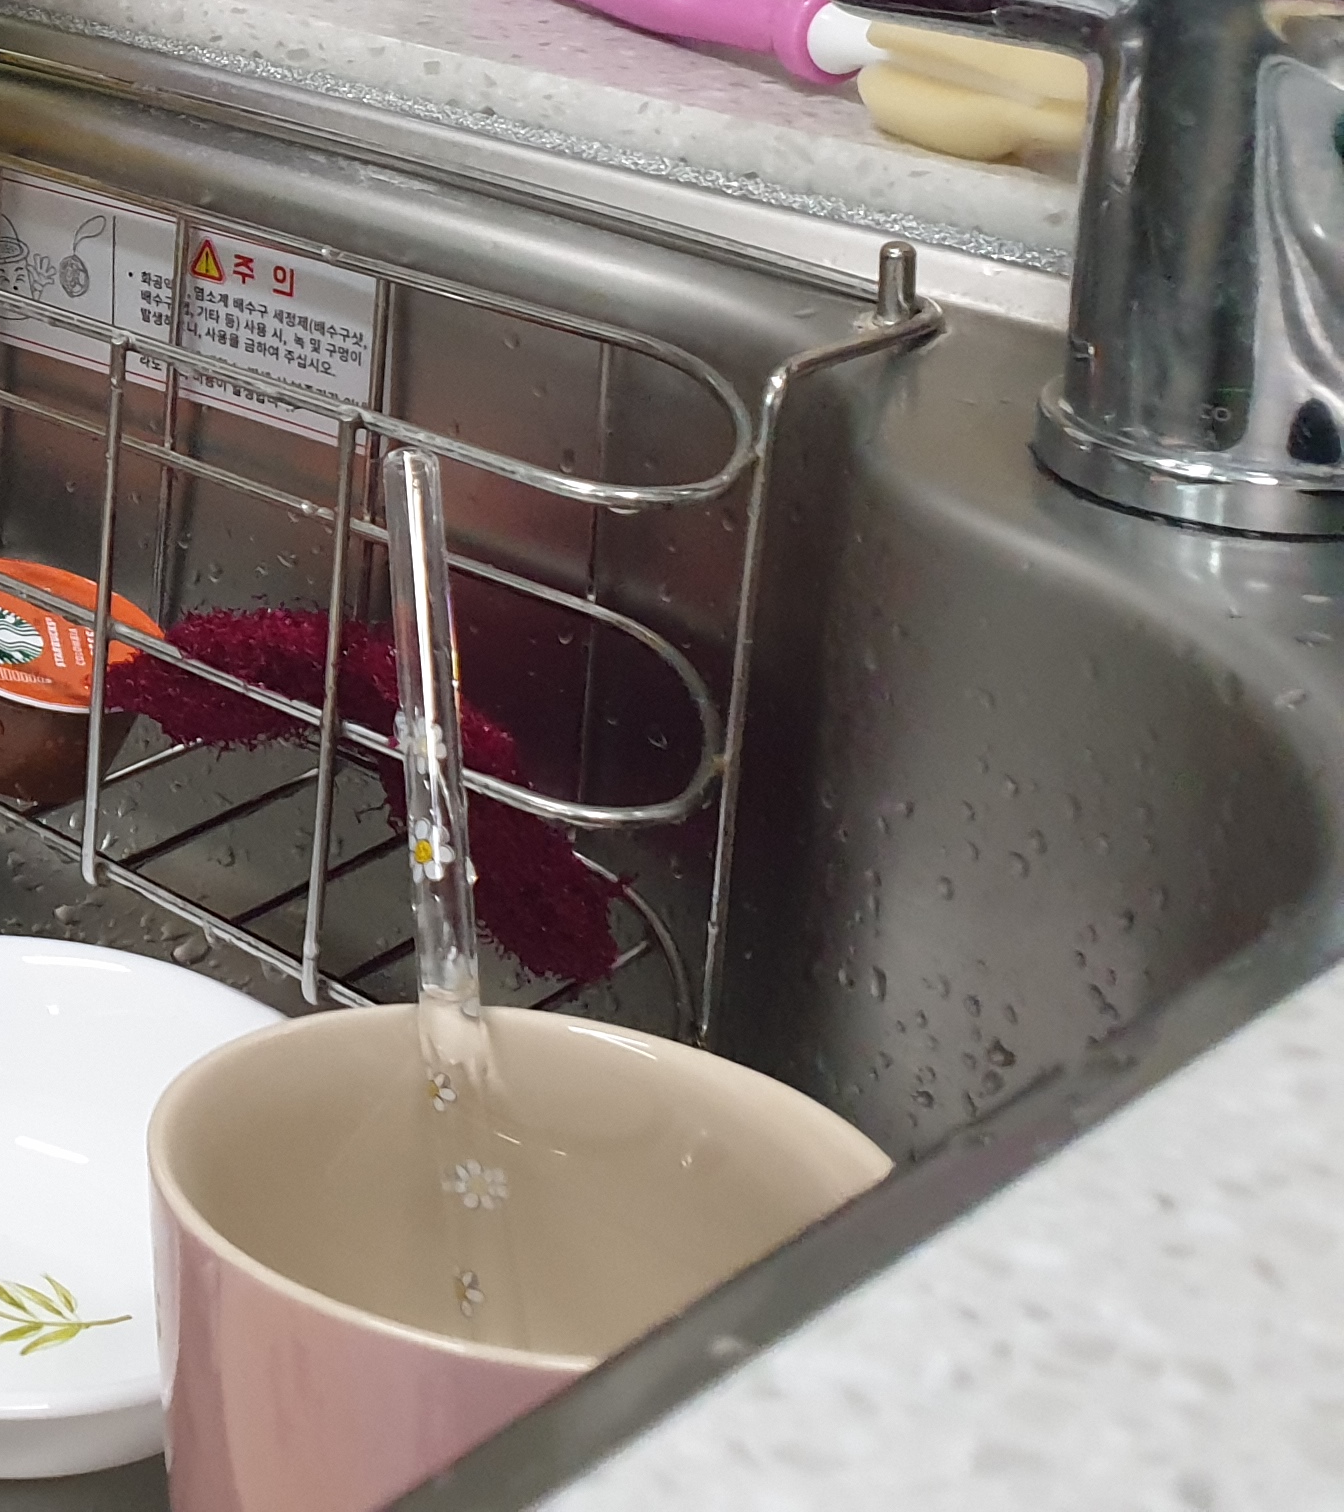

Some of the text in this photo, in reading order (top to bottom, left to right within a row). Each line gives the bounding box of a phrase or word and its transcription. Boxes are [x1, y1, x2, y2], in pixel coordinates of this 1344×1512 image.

[194, 285, 229, 309] 염소계
[233, 297, 269, 319] 배수구
[197, 305, 220, 324] 기타
[224, 312, 240, 331] 등)
[244, 319, 267, 338] 사용
[271, 327, 287, 346] 시,
[309, 337, 321, 355] 및
[325, 342, 362, 367] 구멍이
[205, 327, 239, 348] 사용을
[244, 337, 280, 361] 금하여
[284, 349, 337, 377] 주십시오.
